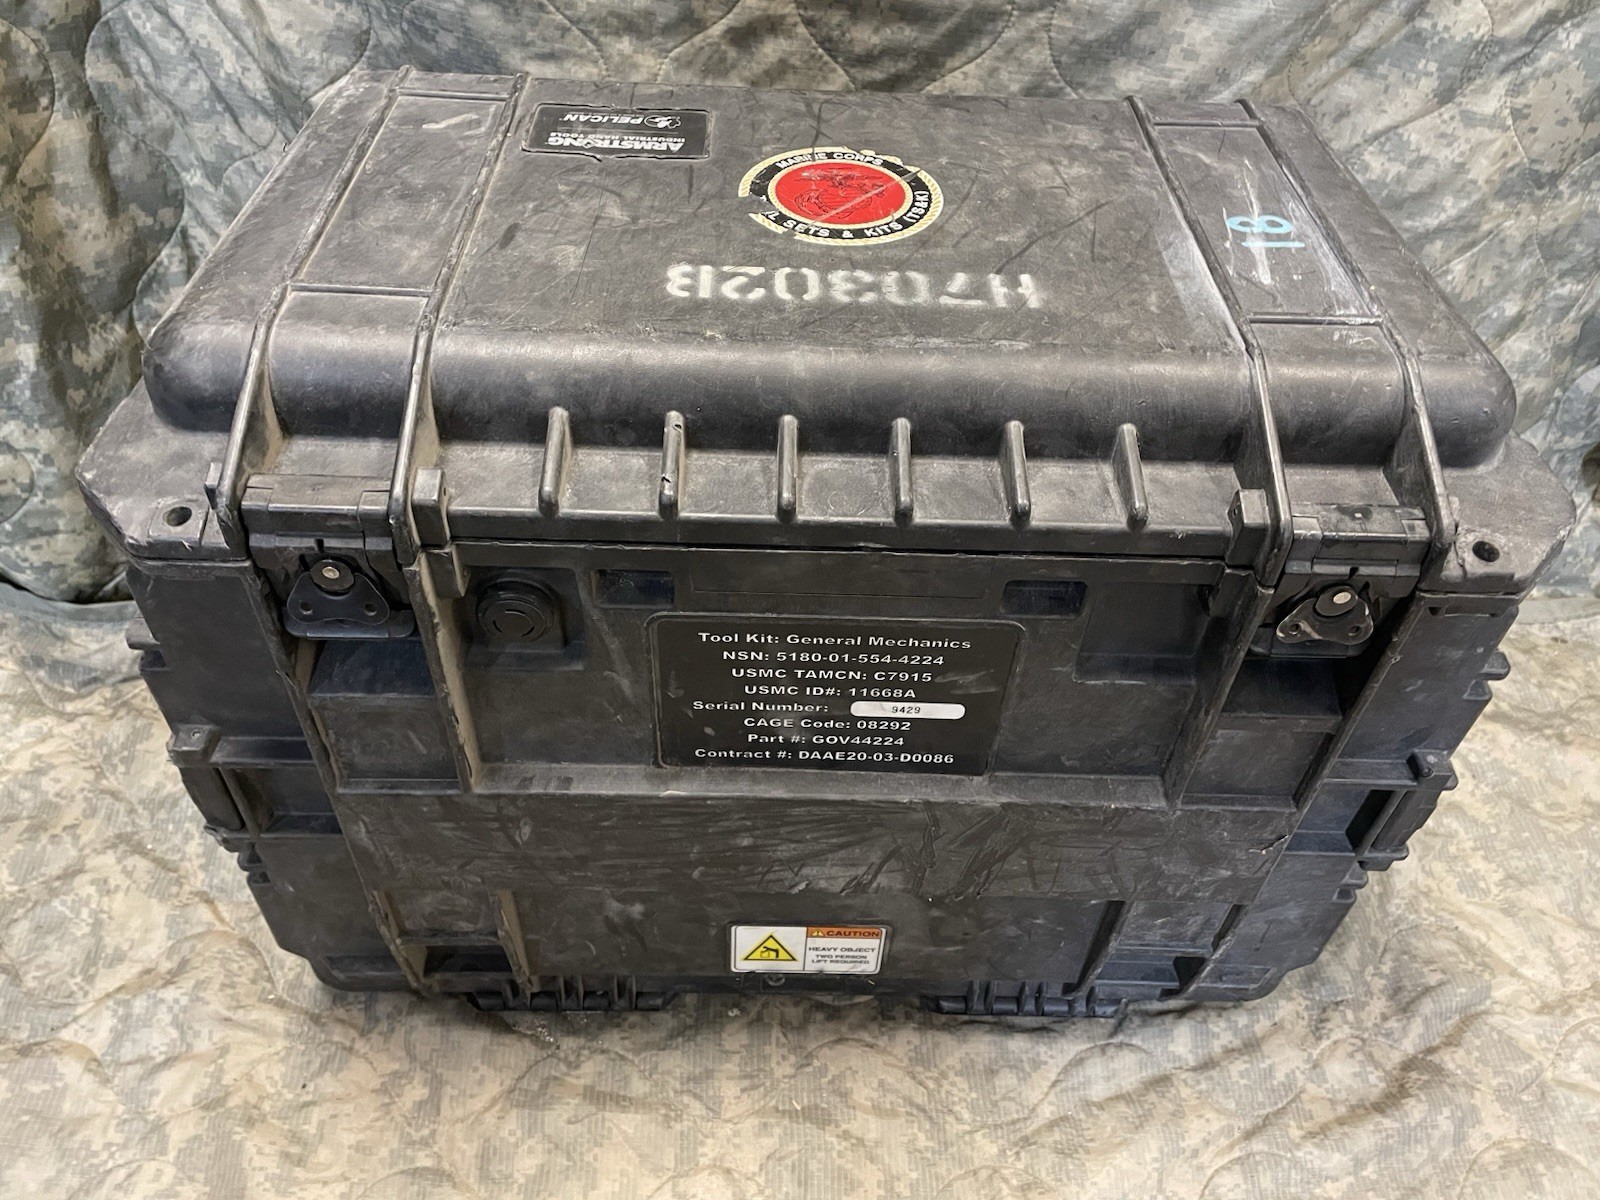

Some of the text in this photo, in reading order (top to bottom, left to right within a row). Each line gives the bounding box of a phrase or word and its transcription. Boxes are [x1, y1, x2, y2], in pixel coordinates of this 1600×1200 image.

[563, 113, 643, 124] PELICAN
[547, 137, 685, 153] ARMSTRONG
[622, 135, 685, 143] INDUSTRIAL
[833, 152, 885, 167] CORPS
[782, 218, 830, 238] SETS
[842, 230, 854, 238] &
[864, 221, 904, 238] KITS
[698, 632, 972, 649] Tool Kit: General Mechanics
[723, 651, 944, 666] NSN: 5180-01-554-4224
[732, 668, 932, 682] USMC TAMCN: C7915
[744, 686, 916, 698] USMC ID#: 11668A
[693, 701, 922, 715] Serial Number: 9429
[744, 718, 912, 731] CAGE Code: 08292
[748, 734, 904, 746] Part #: GOV44224
[694, 748, 954, 764] Contract #: DAAE20-03-D0086
